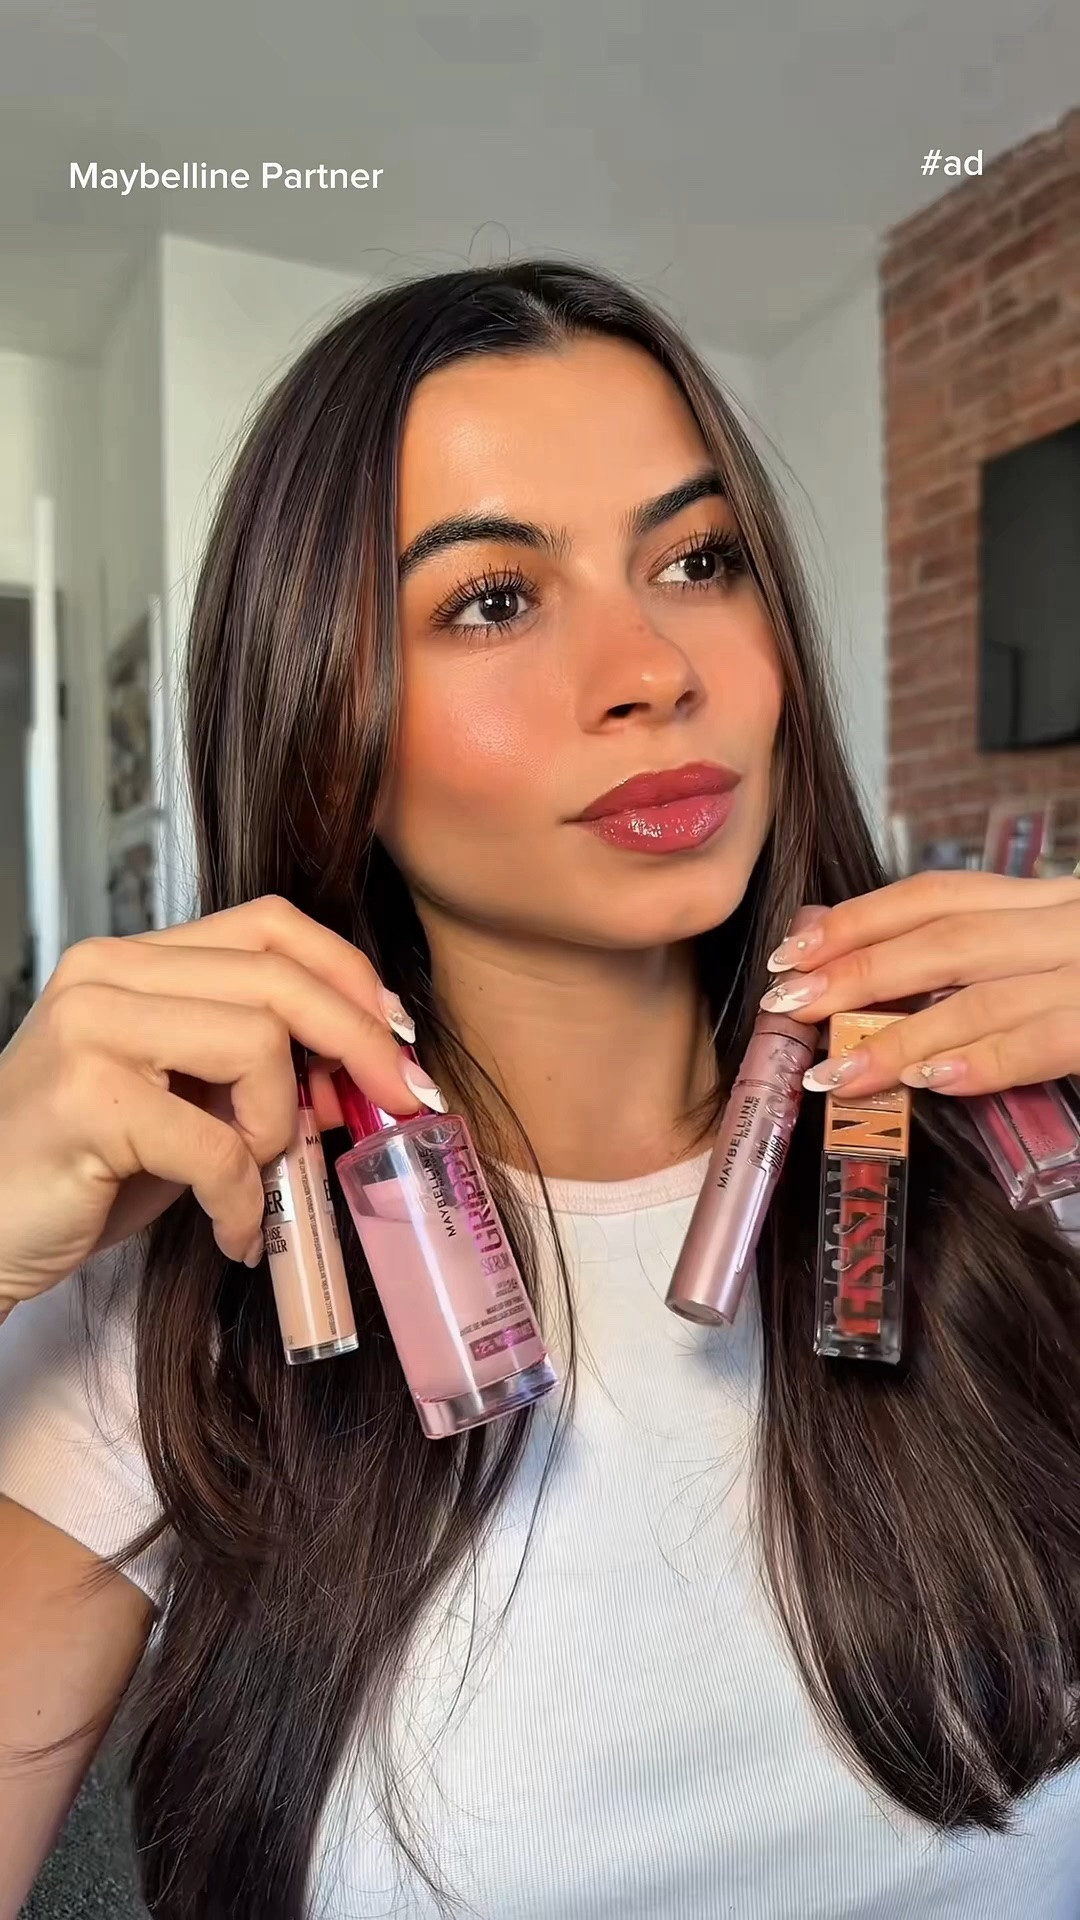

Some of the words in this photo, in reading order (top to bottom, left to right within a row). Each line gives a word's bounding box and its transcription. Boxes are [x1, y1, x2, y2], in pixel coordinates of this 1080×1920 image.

[717, 1095, 755, 1189] MAYBELLINE
[419, 1148, 457, 1237] MAYBELLINE
[442, 1143, 503, 1253] GRIPPY
